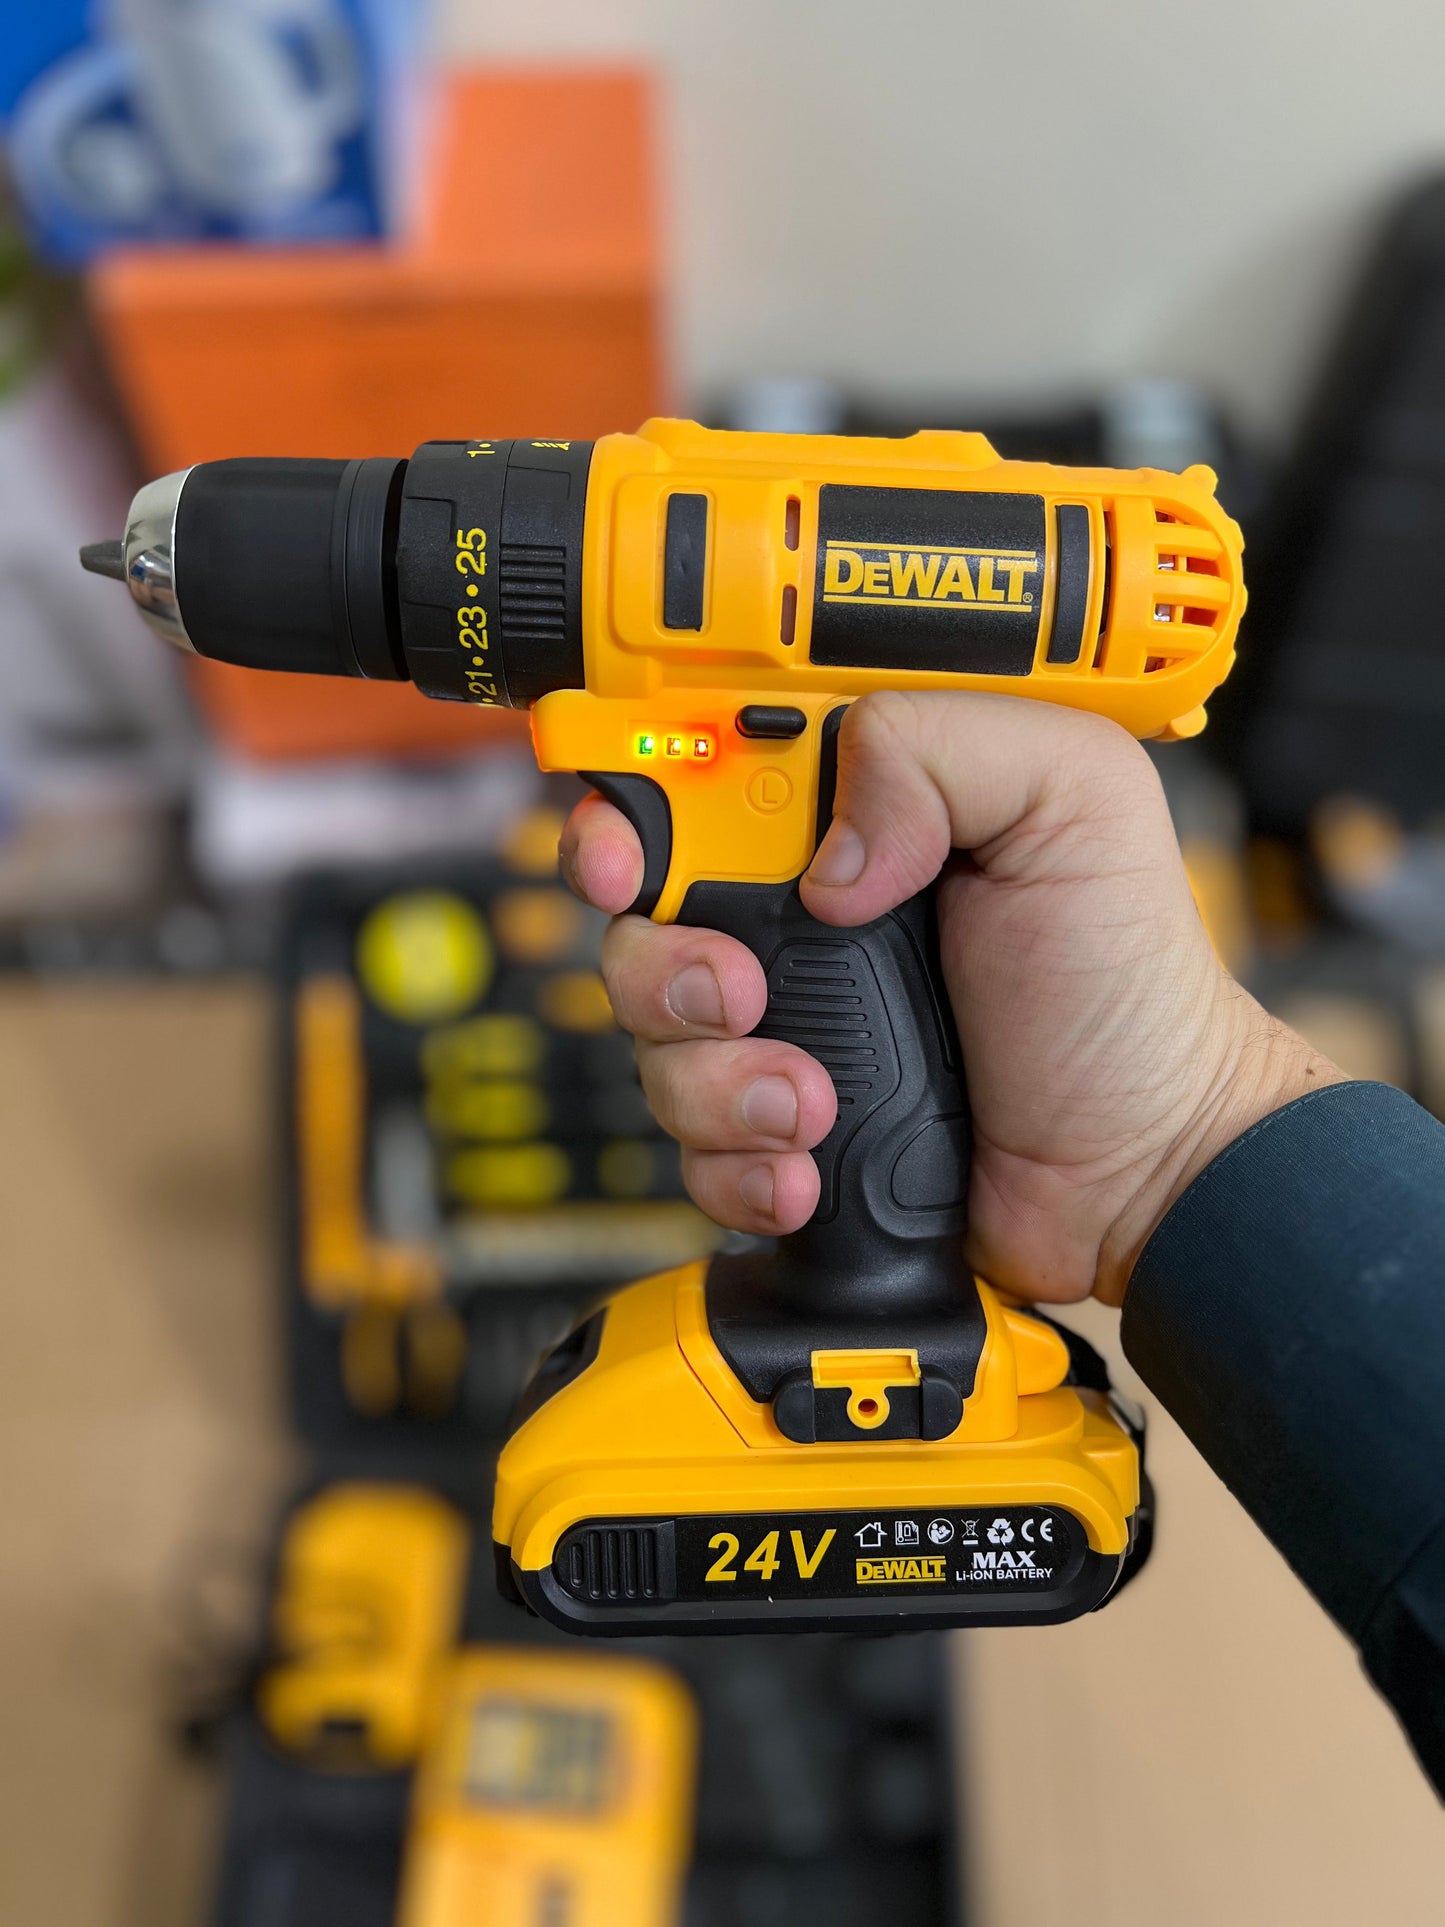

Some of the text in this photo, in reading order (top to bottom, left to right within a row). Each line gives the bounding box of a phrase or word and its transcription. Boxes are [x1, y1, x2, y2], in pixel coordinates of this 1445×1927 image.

[455, 527, 487, 576] 25
[824, 548, 1038, 603] DEWALT
[457, 605, 489, 650] 23
[705, 1529, 837, 1582] 24V
[856, 1559, 946, 1581] DEWALT
[972, 1550, 1037, 1569] MAX
[996, 1567, 1054, 1580] BATTERY
